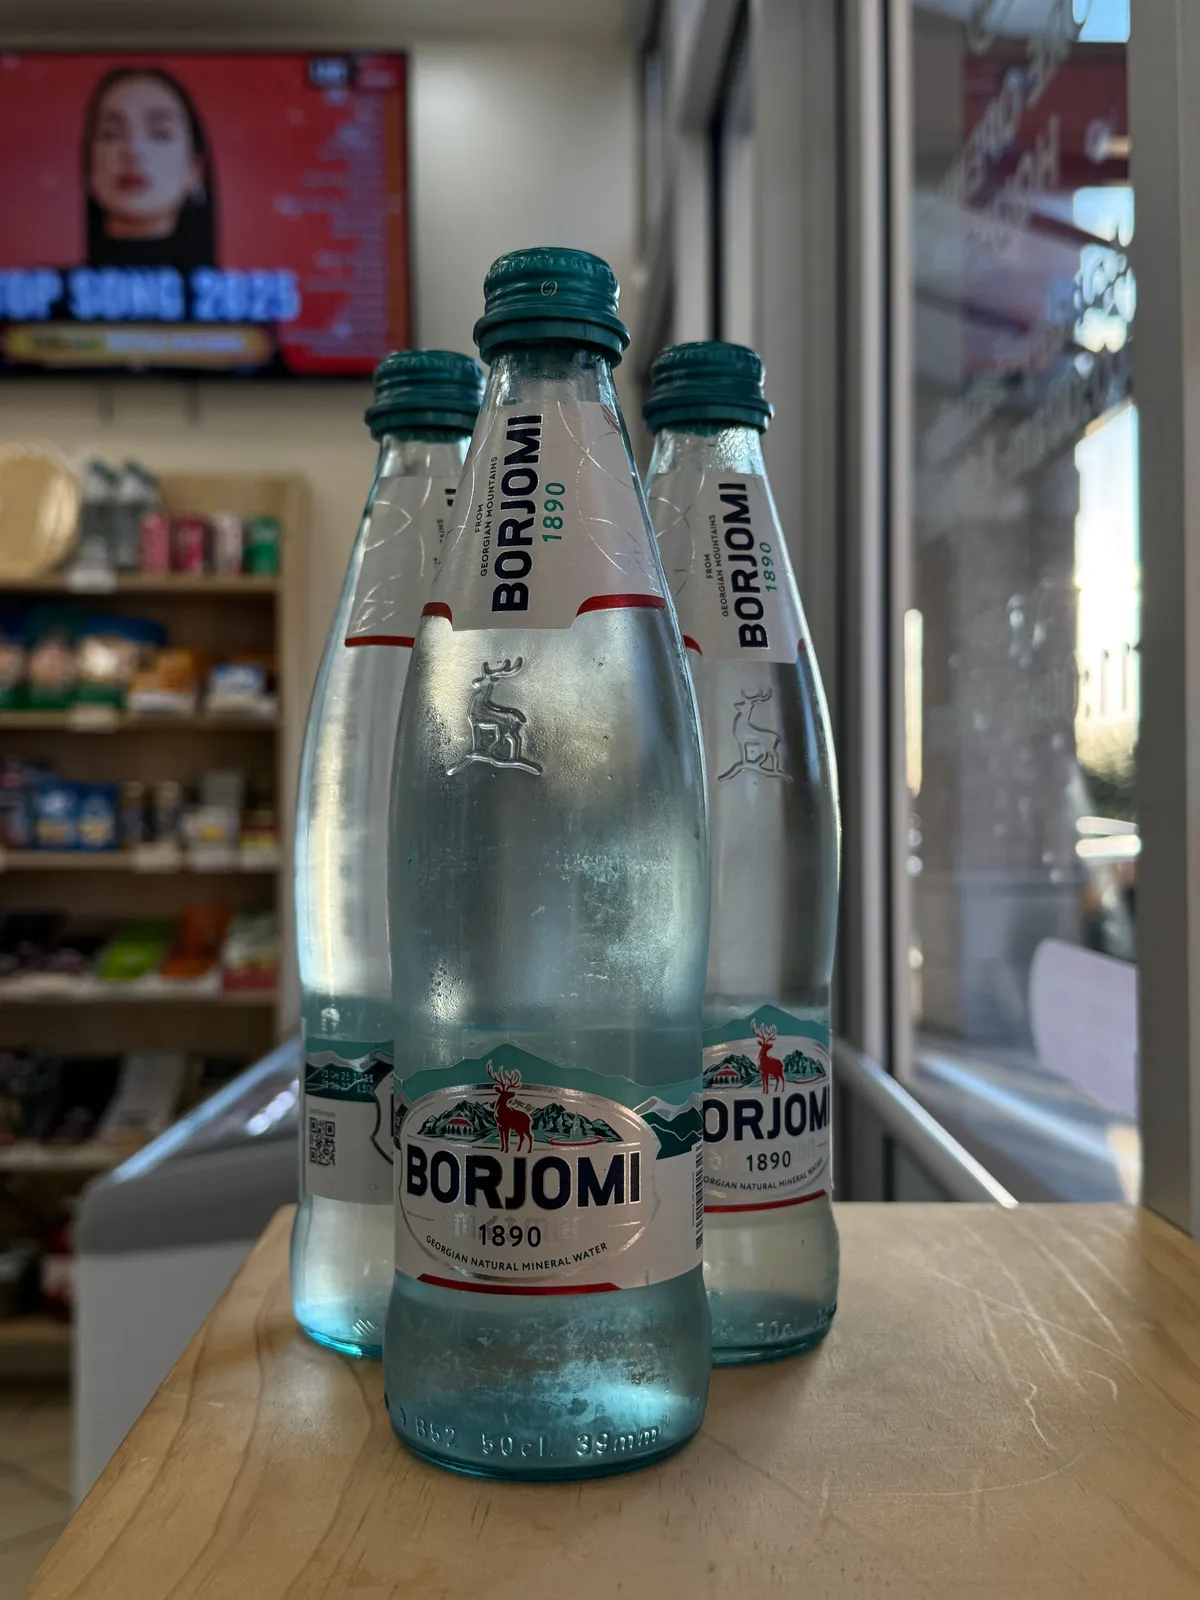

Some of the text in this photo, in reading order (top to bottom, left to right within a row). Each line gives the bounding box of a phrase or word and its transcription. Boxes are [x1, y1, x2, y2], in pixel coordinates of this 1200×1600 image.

[475, 504, 484, 533] FROM
[480, 456, 498, 576] GEORGIAN MOUNTAINS
[491, 414, 543, 612] BORJOMI
[542, 482, 566, 542] 1890
[706, 554, 714, 579] FROM
[708, 514, 729, 617] GEORGIAN MOUNTAINS
[718, 483, 769, 648] BORJOMI
[759, 542, 777, 592] 1890
[406, 1143, 641, 1210] BORJOMI
[739, 1181, 777, 1190] NATURAL
[778, 1174, 807, 1187] MINERAL
[746, 1150, 791, 1172] 1890
[425, 1234, 608, 1271] GEORGIAN NATURAL MINERAL WATER
[478, 1224, 542, 1248] 1890
